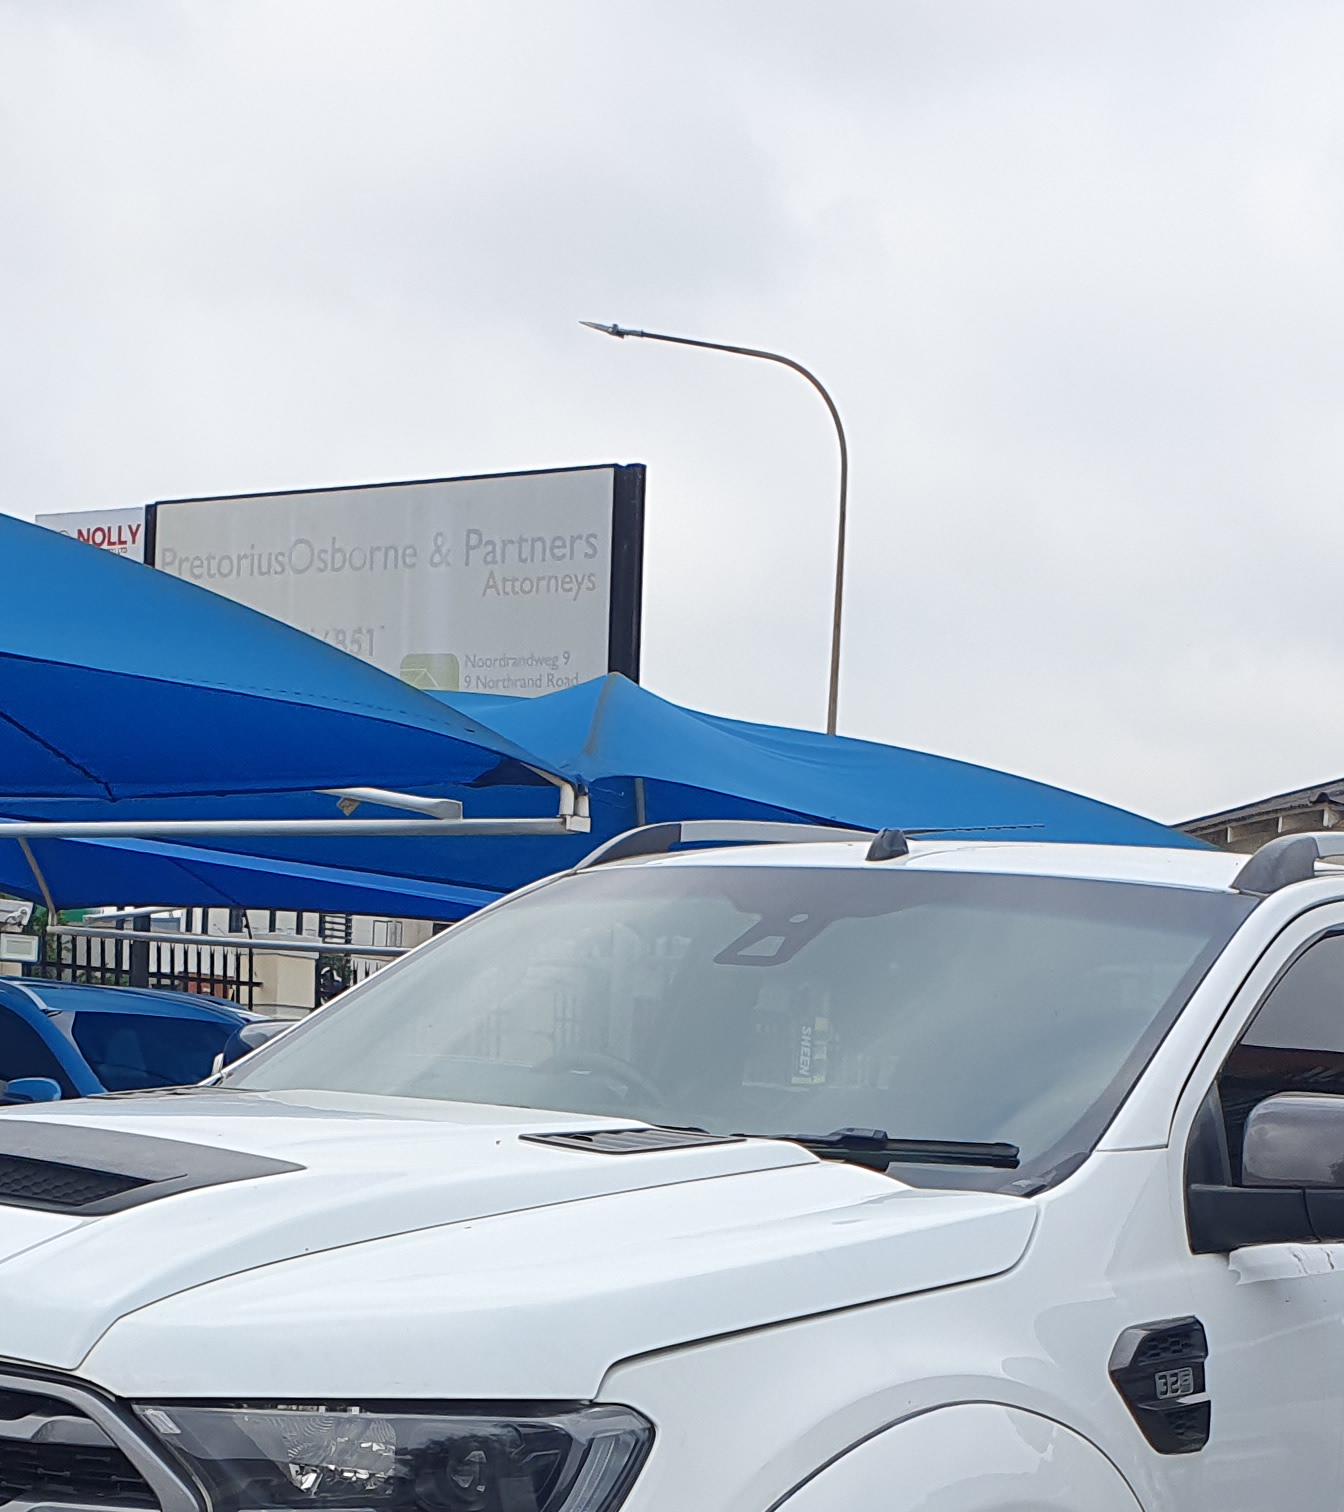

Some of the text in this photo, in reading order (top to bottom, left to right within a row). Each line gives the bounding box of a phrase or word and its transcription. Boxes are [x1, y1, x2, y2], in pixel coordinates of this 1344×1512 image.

[77, 523, 141, 547] NOLLY
[429, 531, 452, 568] &
[464, 528, 599, 567] Partners
[482, 570, 597, 601] Attorneys
[562, 651, 571, 667] 9
[464, 672, 579, 690] 9 Northrand Road
